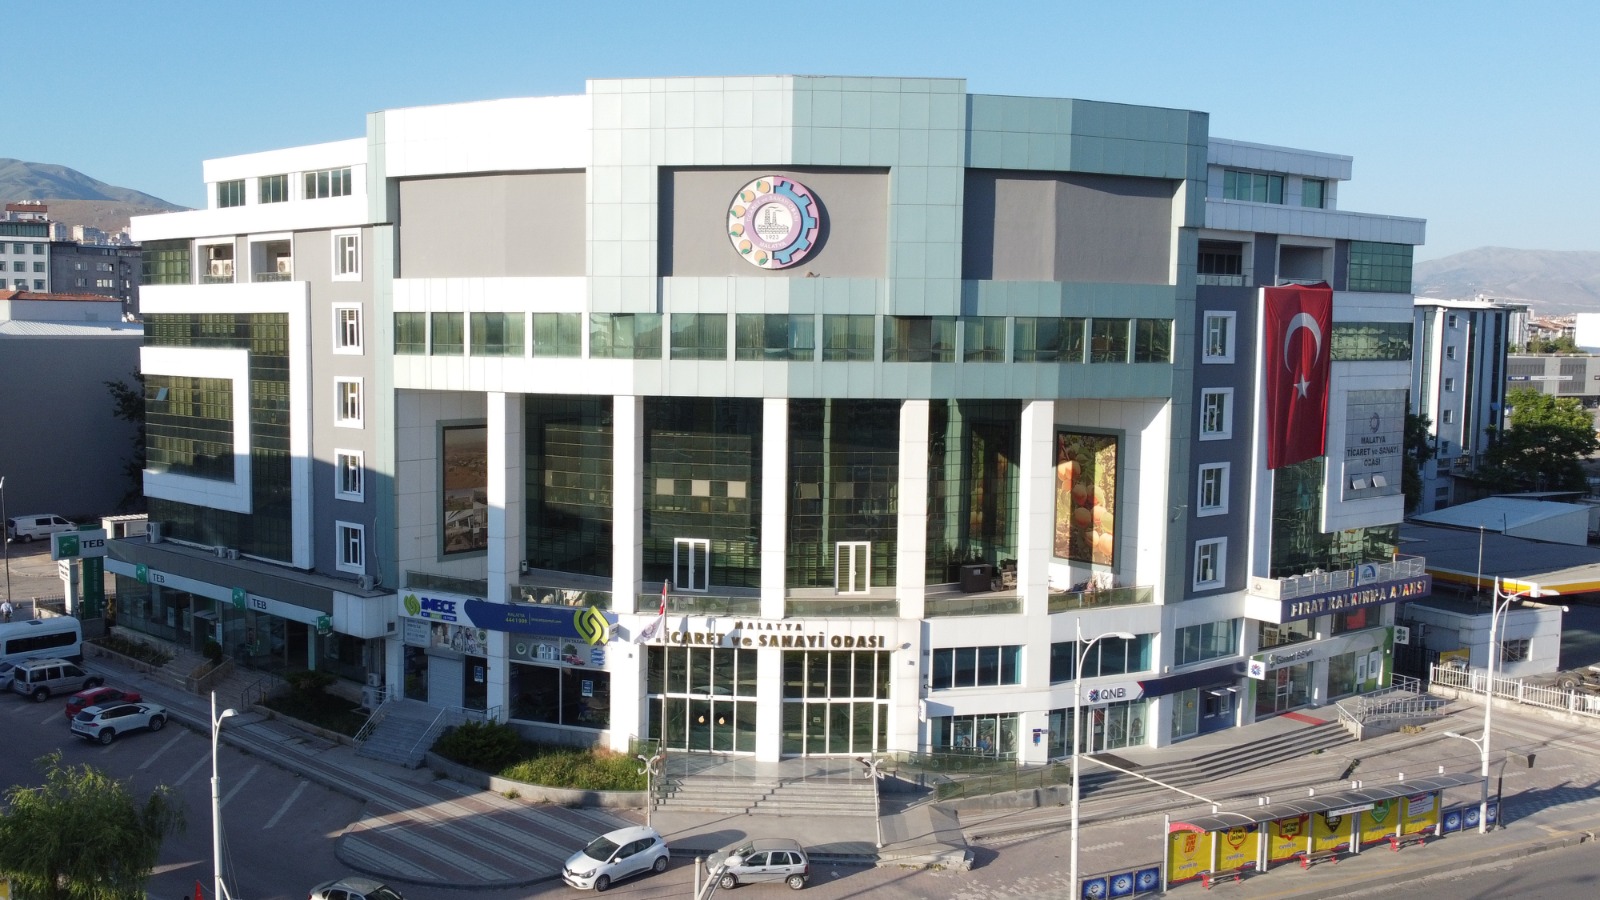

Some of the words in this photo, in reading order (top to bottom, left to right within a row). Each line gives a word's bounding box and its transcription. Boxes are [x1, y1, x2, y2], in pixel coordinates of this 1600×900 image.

[759, 241, 787, 249] MALATYA
[1361, 435, 1386, 444] MALATYA
[1347, 446, 1370, 457] TİCARET
[81, 539, 104, 548] TEB
[153, 573, 165, 583] TEB
[252, 598, 267, 610] TEB
[1291, 598, 1325, 617] FIRAT
[1328, 588, 1386, 610] KALKINMA
[735, 621, 802, 631] MALATYA
[656, 628, 725, 646] İCARET
[731, 636, 753, 646] ve
[759, 632, 825, 648] SANAYİ
[831, 635, 885, 648] ODASI
[1101, 687, 1125, 700] QNB
